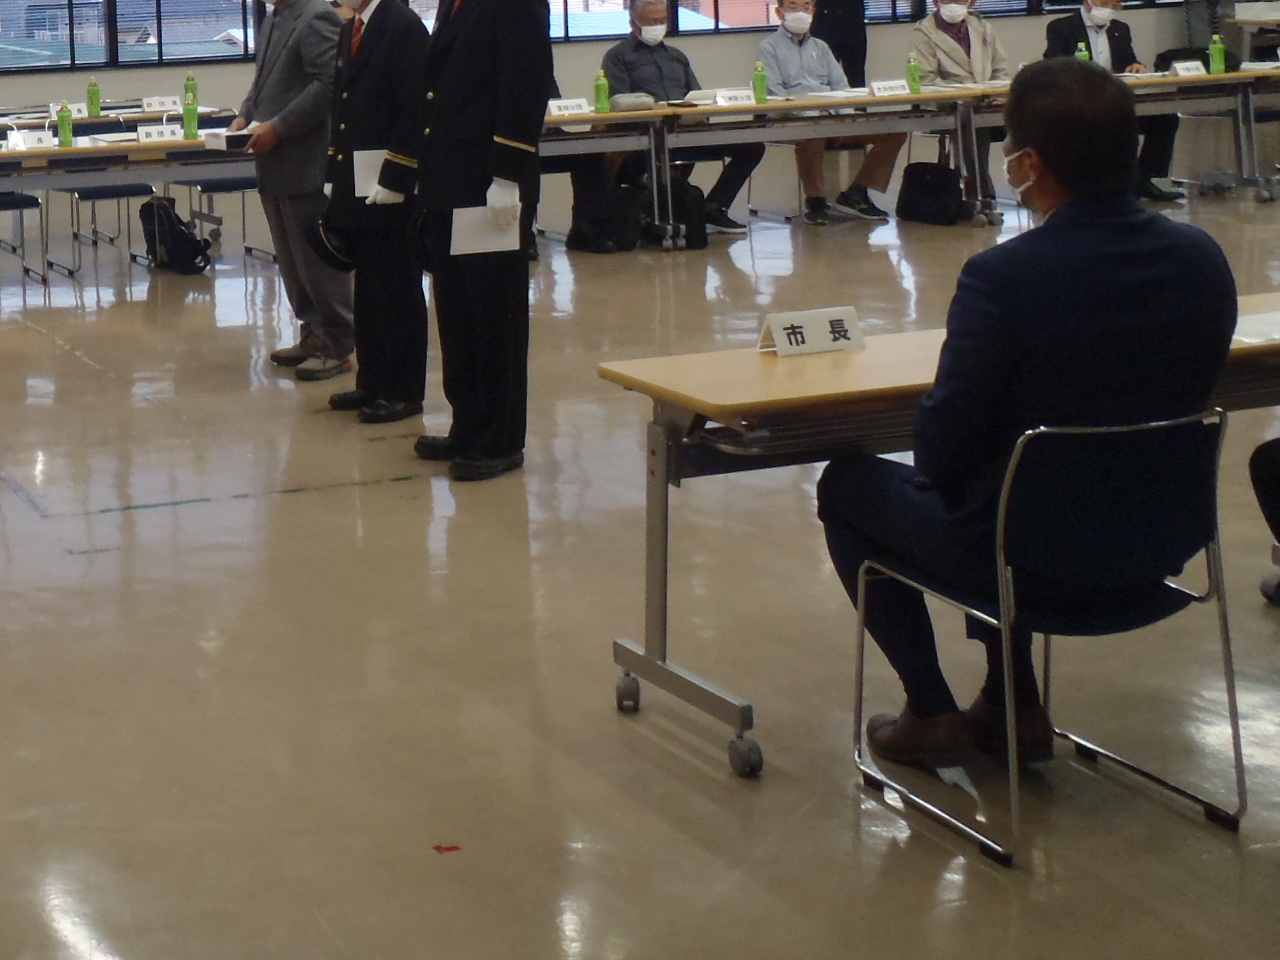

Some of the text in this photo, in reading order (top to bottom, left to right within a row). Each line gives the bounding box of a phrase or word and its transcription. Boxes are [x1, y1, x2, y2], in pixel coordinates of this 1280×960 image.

[145, 129, 177, 139] 副団長
[782, 318, 851, 347] 市長
